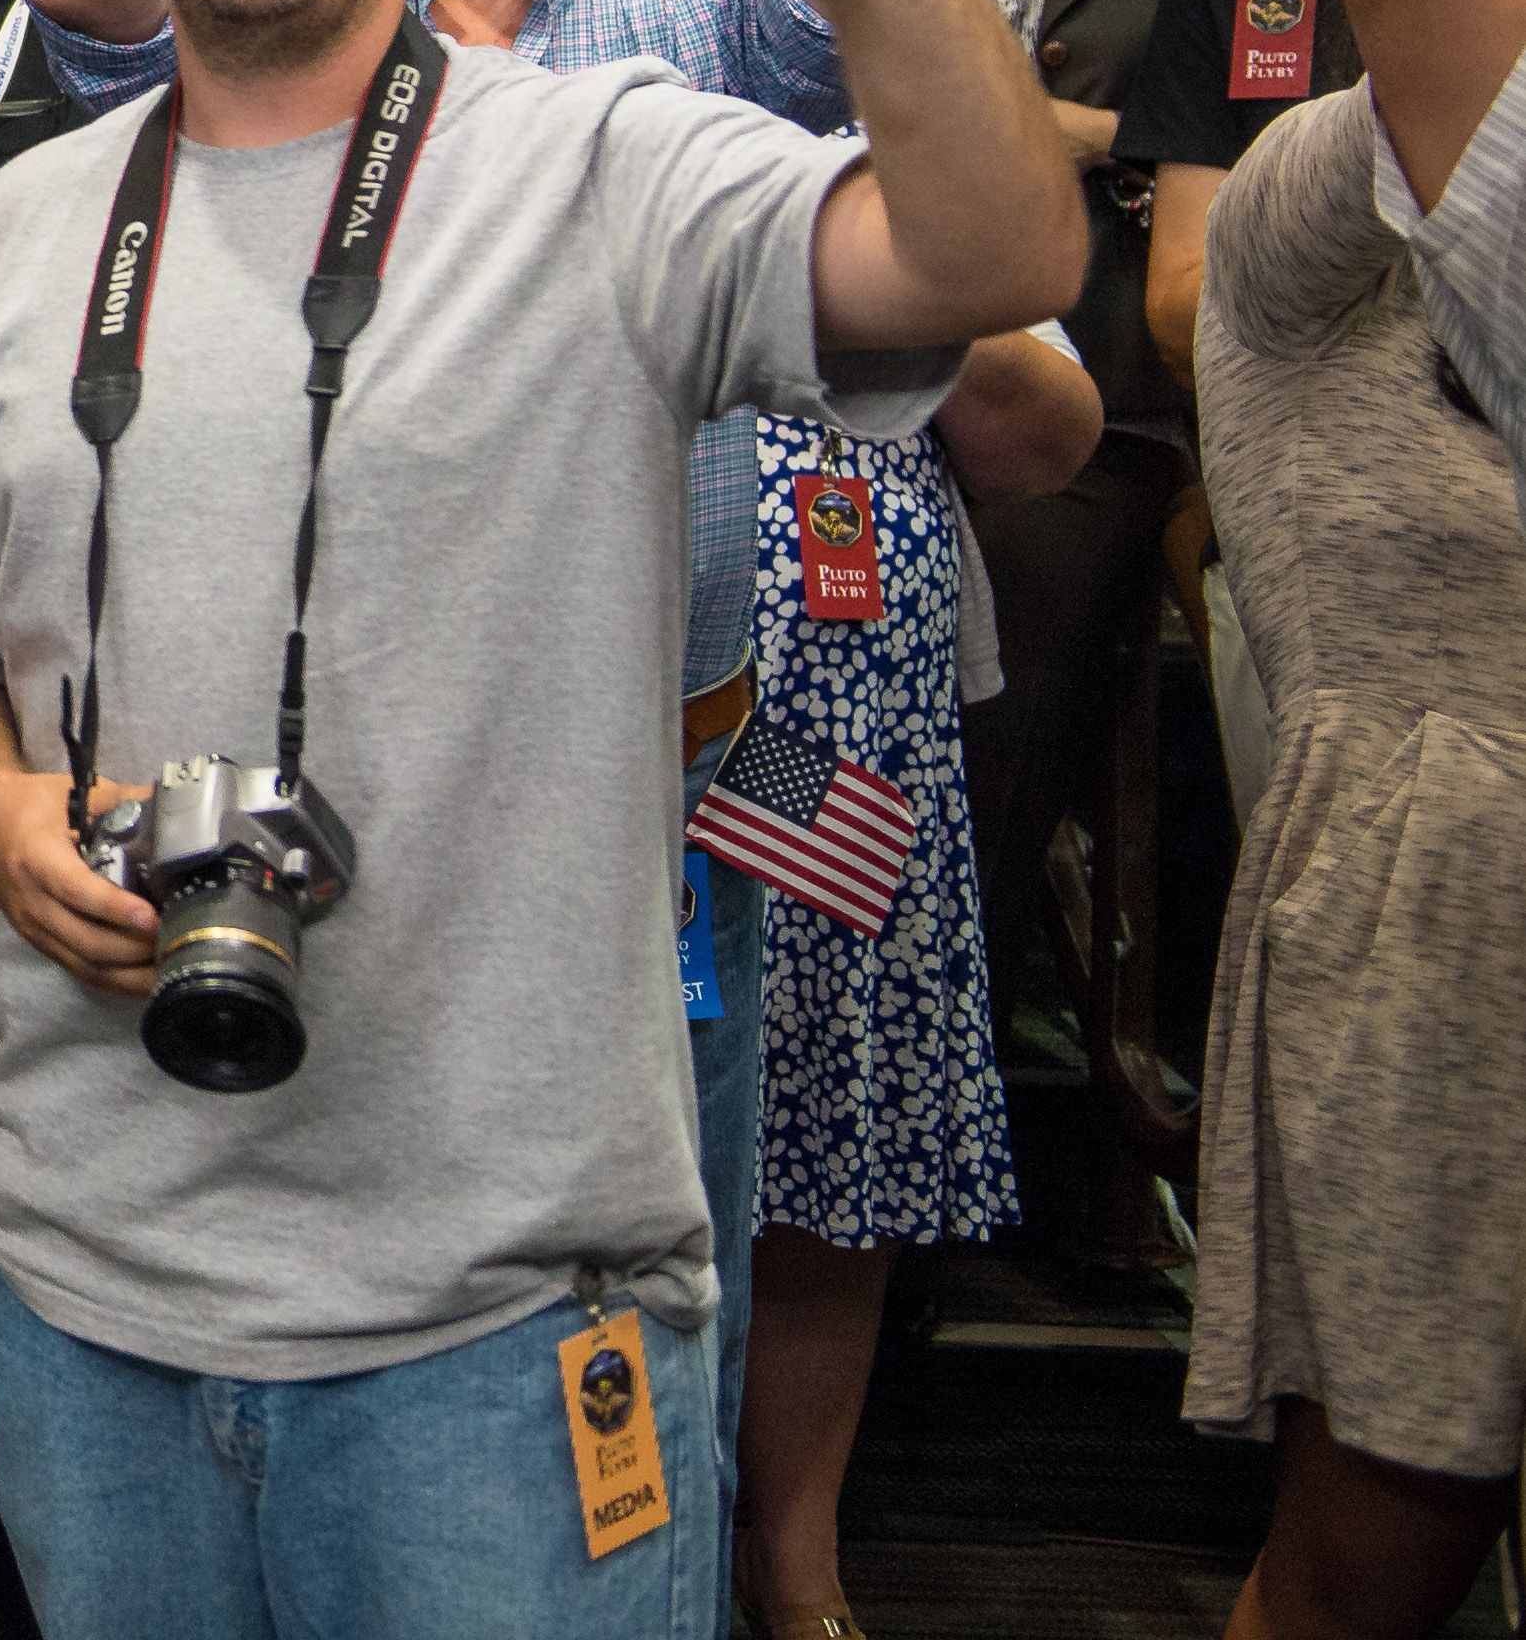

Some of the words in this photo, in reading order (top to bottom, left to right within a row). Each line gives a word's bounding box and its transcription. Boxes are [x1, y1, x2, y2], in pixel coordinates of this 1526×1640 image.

[0, 16, 22, 70] Horizons
[380, 64, 421, 123] EOS
[341, 130, 399, 248] DIGITAL
[100, 221, 148, 335] Canon
